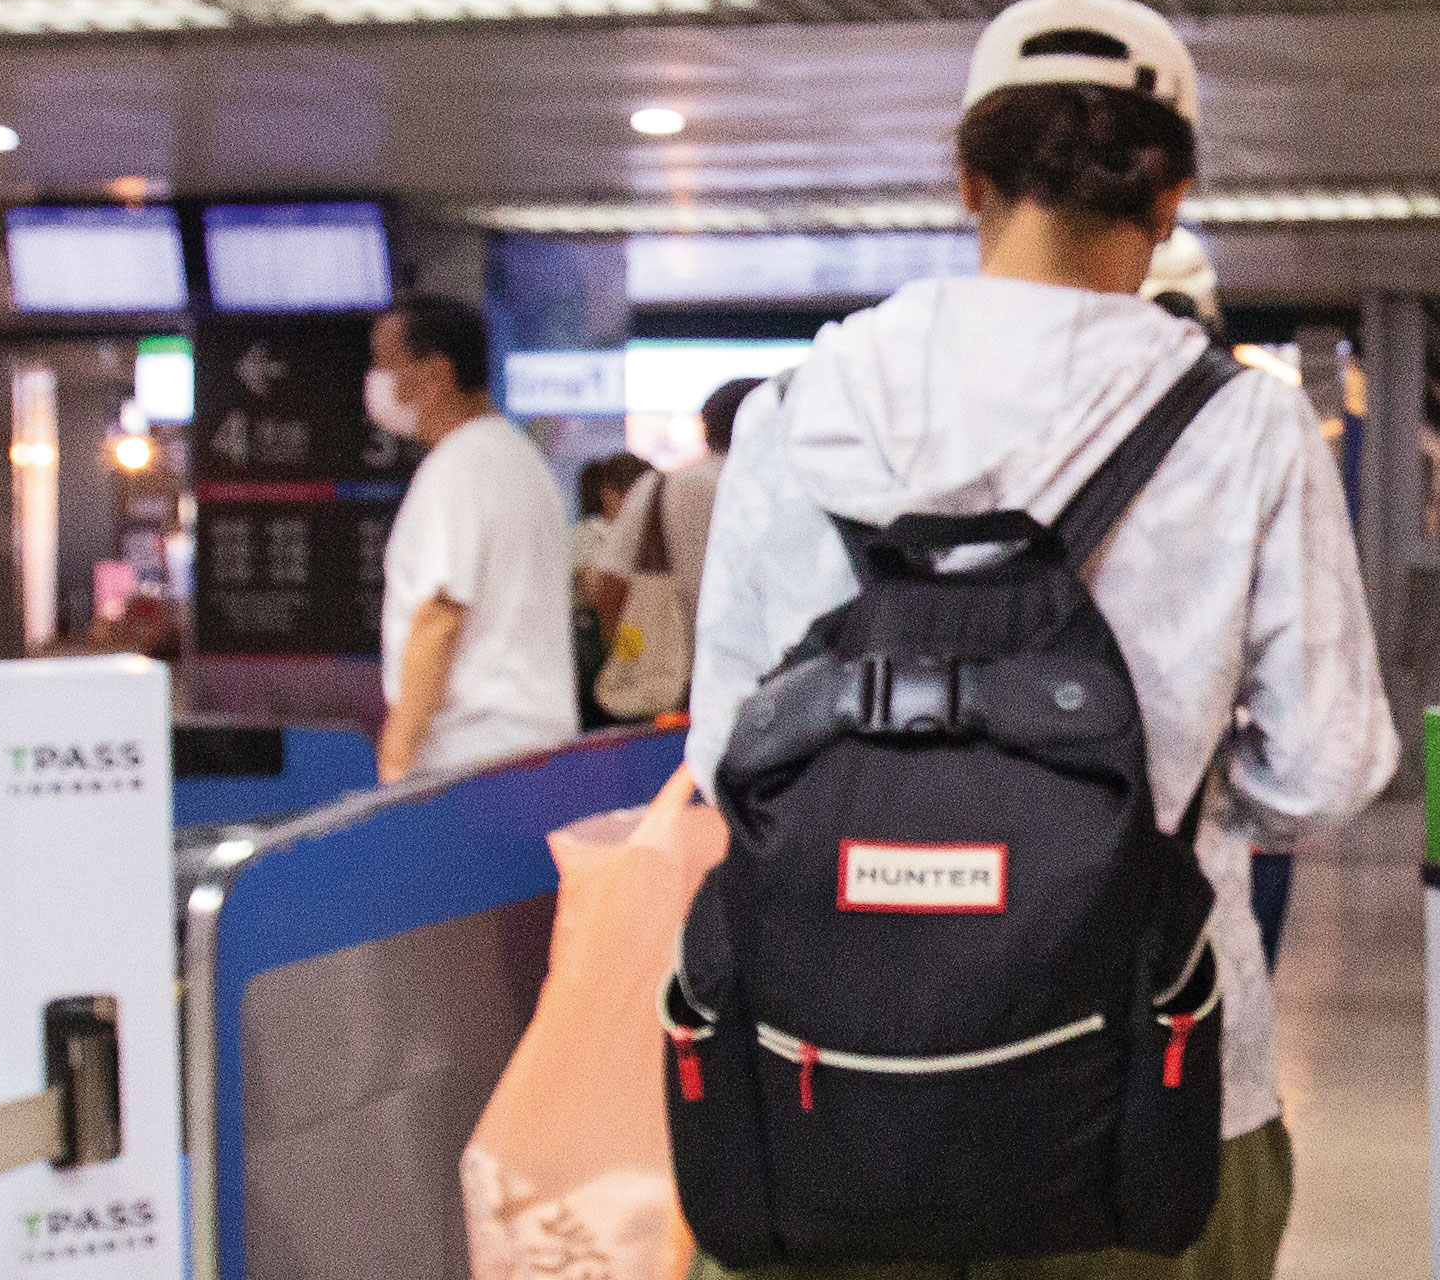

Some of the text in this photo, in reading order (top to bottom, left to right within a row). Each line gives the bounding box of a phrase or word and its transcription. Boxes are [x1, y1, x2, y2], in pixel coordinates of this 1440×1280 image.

[6, 740, 142, 773] TPASS
[854, 863, 994, 890] HUNTER
[21, 1200, 157, 1238] TPASS
